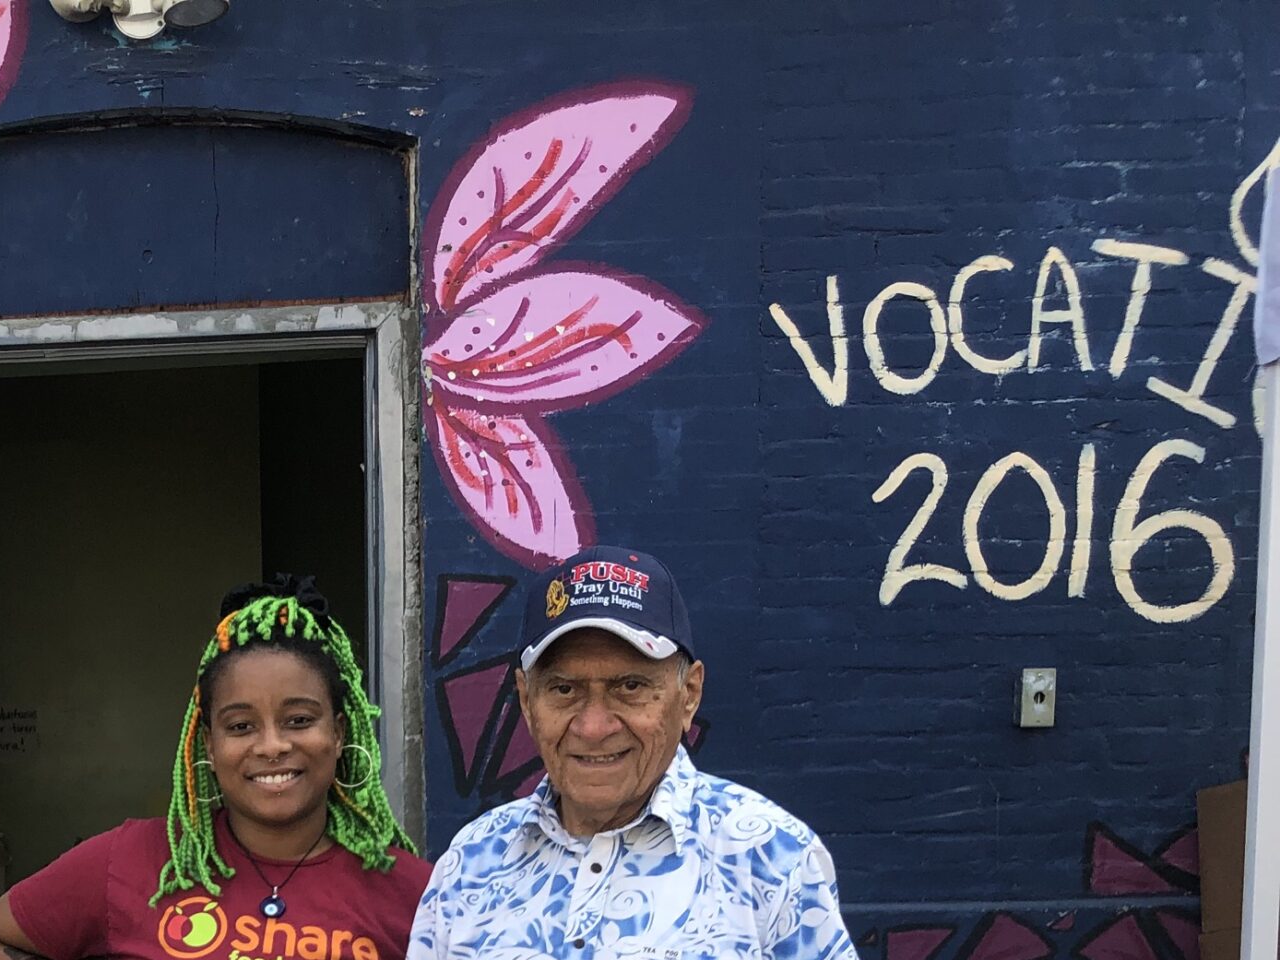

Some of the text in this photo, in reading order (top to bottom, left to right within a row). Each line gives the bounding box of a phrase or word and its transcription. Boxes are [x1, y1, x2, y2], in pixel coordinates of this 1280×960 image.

[872, 438, 1236, 624] 2016
[571, 561, 649, 593] PUSH
[569, 594, 643, 612] Something Happens
[574, 581, 642, 600] Pray Until
